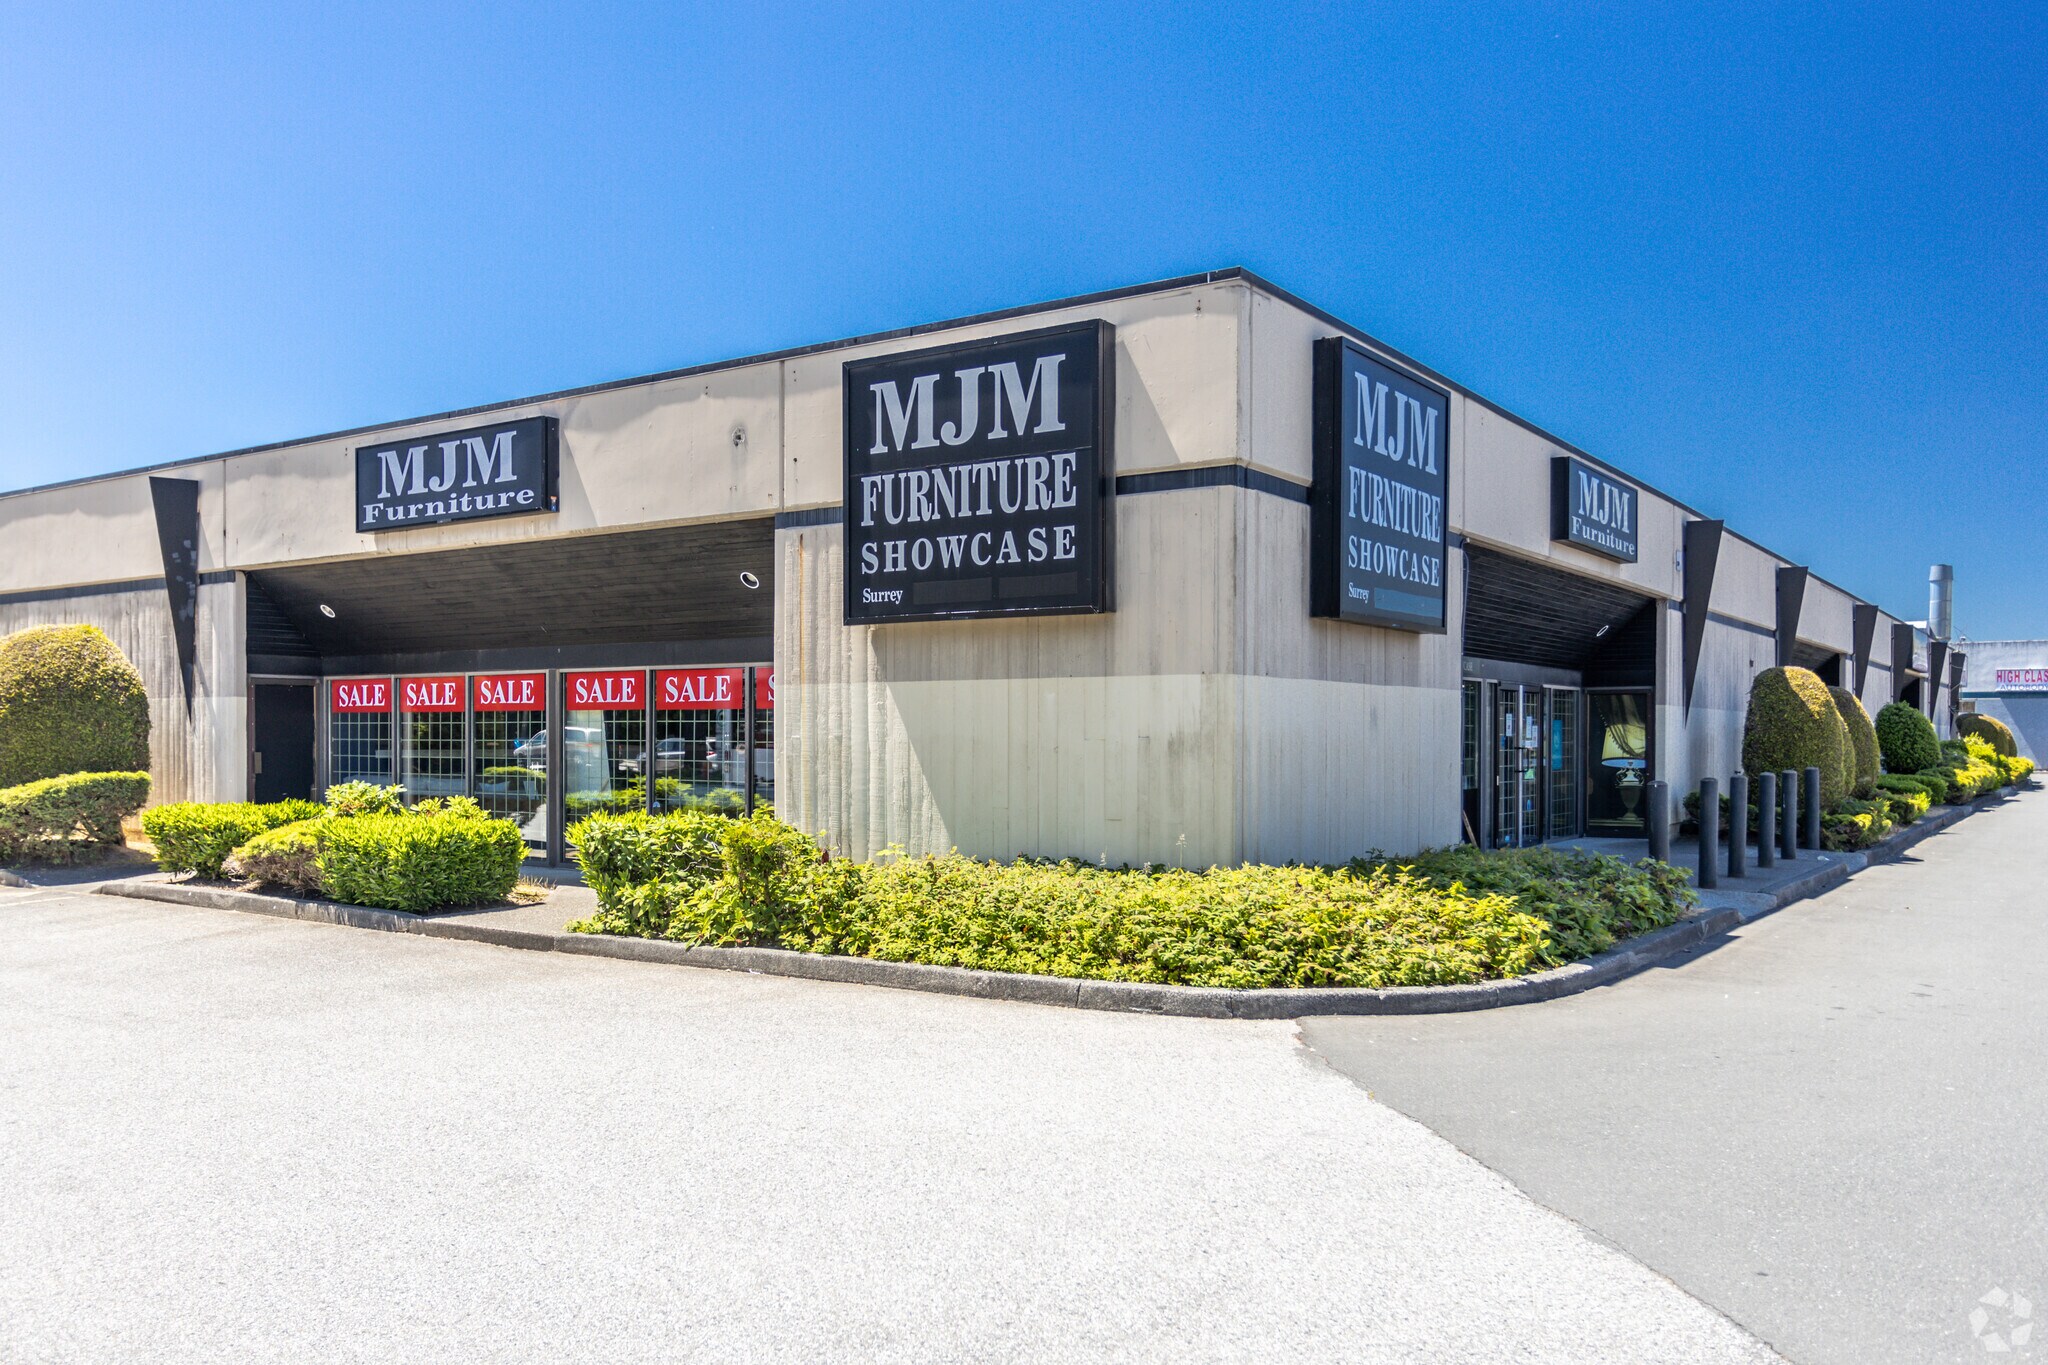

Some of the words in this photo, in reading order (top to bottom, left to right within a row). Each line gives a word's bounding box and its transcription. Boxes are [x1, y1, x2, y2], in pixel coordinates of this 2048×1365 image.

[869, 353, 1066, 455] MJM
[1353, 371, 1438, 475] MJM
[377, 430, 517, 499] MJM
[363, 489, 535, 524] Furniture
[861, 452, 1076, 526] FURNITURE
[1348, 465, 1440, 543] FURNITURE
[1578, 470, 1630, 534] MJM
[861, 525, 1076, 575] SHOWCASE
[1571, 516, 1635, 555] Furniture
[1348, 535, 1440, 587] SHOWCASE
[862, 587, 904, 604] Surrey
[1348, 582, 1370, 604] Surrey
[406, 682, 456, 706] SALE
[480, 679, 535, 705] SALE
[575, 677, 636, 705] SALE
[665, 675, 732, 703] SALE
[1997, 669, 2020, 683] HIGH
[2024, 669, 2048, 683] CLAS
[339, 684, 386, 707] SALE
